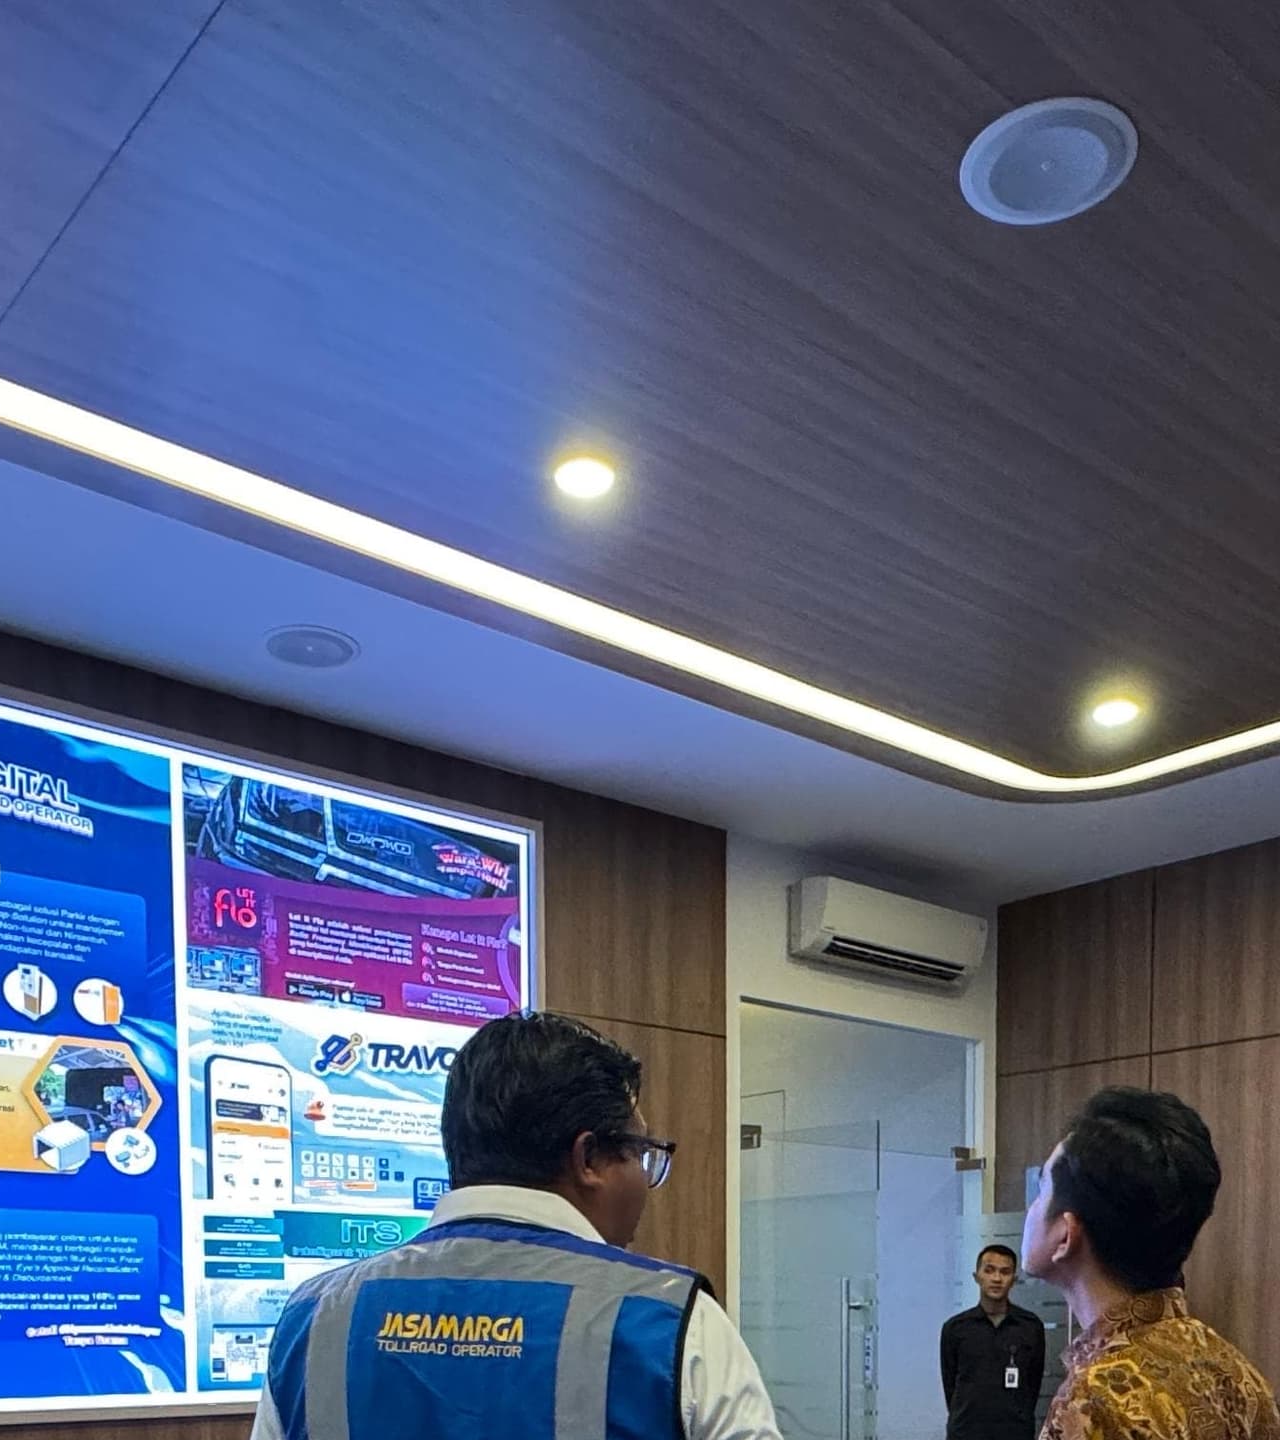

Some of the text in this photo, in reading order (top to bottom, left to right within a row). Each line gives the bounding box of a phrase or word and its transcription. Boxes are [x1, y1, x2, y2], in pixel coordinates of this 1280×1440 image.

[13, 799, 91, 833] OPERATOR
[341, 1218, 402, 1245] ITS
[292, 1246, 354, 1259] Intelligent
[377, 1312, 523, 1343] JASAMARGA
[377, 1339, 522, 1358] TOLLROAD OPERATOR
